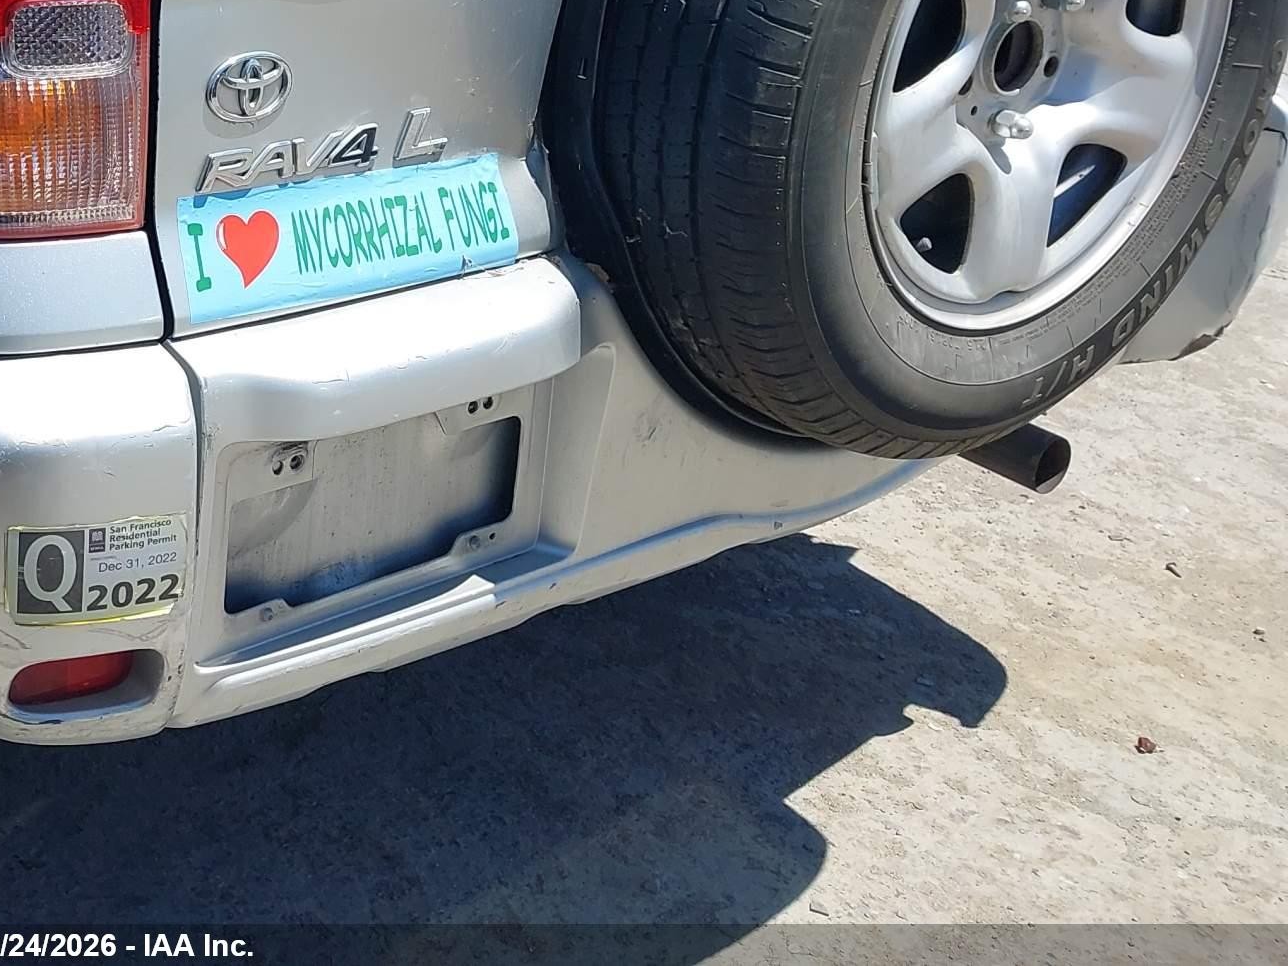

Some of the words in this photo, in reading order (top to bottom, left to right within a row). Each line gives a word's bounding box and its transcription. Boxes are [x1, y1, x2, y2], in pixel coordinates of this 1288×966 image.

[194, 122, 378, 194] RAV4
[394, 107, 448, 166] L
[187, 223, 212, 292] I
[290, 195, 443, 275] MYCORRHIZAL
[437, 181, 510, 252] FUNGI
[1022, 344, 1096, 406] H/T
[109, 525, 127, 534] San
[129, 518, 172, 532] Francisco
[109, 530, 161, 542] Residential
[109, 539, 145, 551] Parking
[147, 534, 177, 546] Permit
[23, 534, 77, 612] Q
[98, 561, 122, 573] Dec
[125, 558, 145, 569] 31,
[147, 551, 177, 566] 2022
[86, 573, 179, 612] 2022
